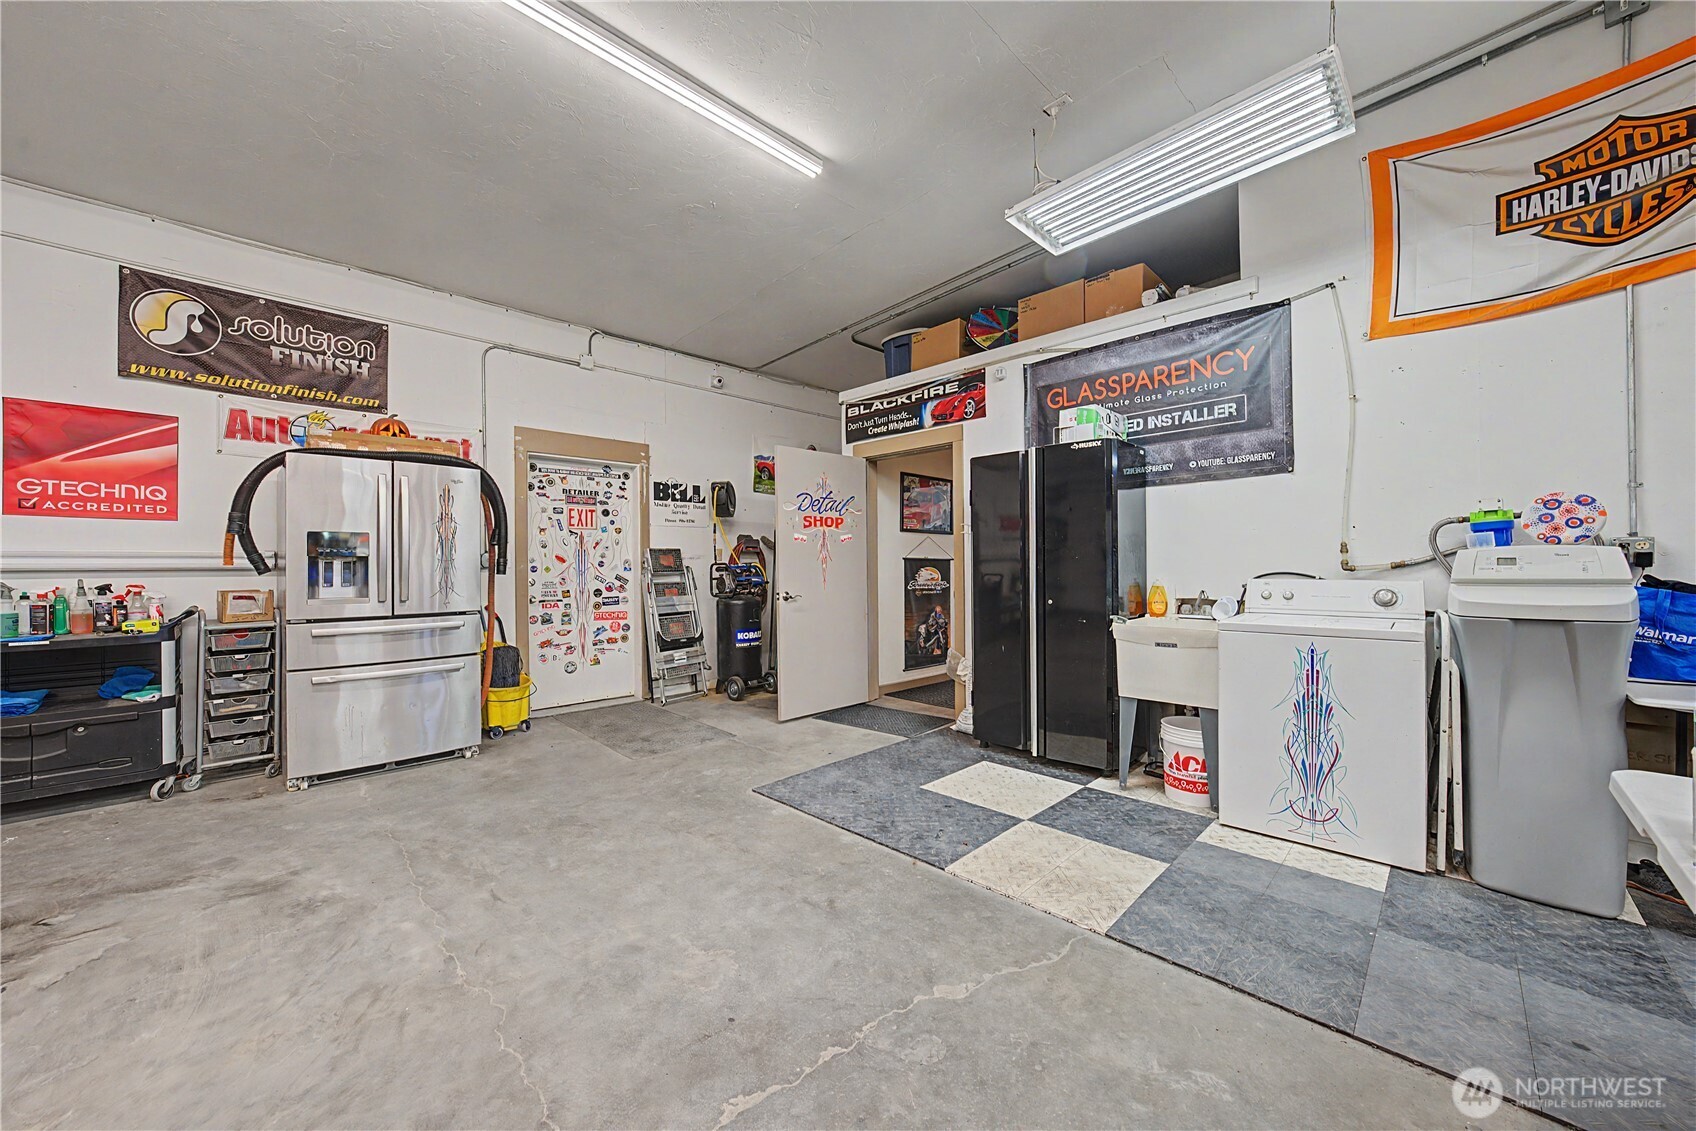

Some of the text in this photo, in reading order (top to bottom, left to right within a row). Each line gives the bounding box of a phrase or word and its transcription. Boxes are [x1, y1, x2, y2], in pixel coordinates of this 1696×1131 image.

[1562, 119, 1687, 173] MOTOR
[1562, 179, 1688, 234] CYCLES
[228, 316, 376, 361] solution
[129, 364, 380, 408] www.solutionfinish.com
[1046, 345, 1255, 409] GLASSPARENCY
[847, 381, 959, 418] BLACKFIRE
[1166, 381, 1228, 397] Protection
[867, 417, 920, 435] Create Whiplash!
[1147, 402, 1237, 429] INSTALLER
[1078, 440, 1102, 448] HUSKY
[1197, 451, 1276, 468] YOUTUBE: GLASSPARENCY
[16, 478, 168, 501] GTECHNIQ
[562, 488, 600, 497] DETAILER
[42, 500, 168, 514] ACCREDITED
[796, 490, 856, 517] Detail
[568, 508, 596, 527] EXIT
[803, 515, 845, 529] SHOP
[1635, 625, 1696, 645] Walmar
